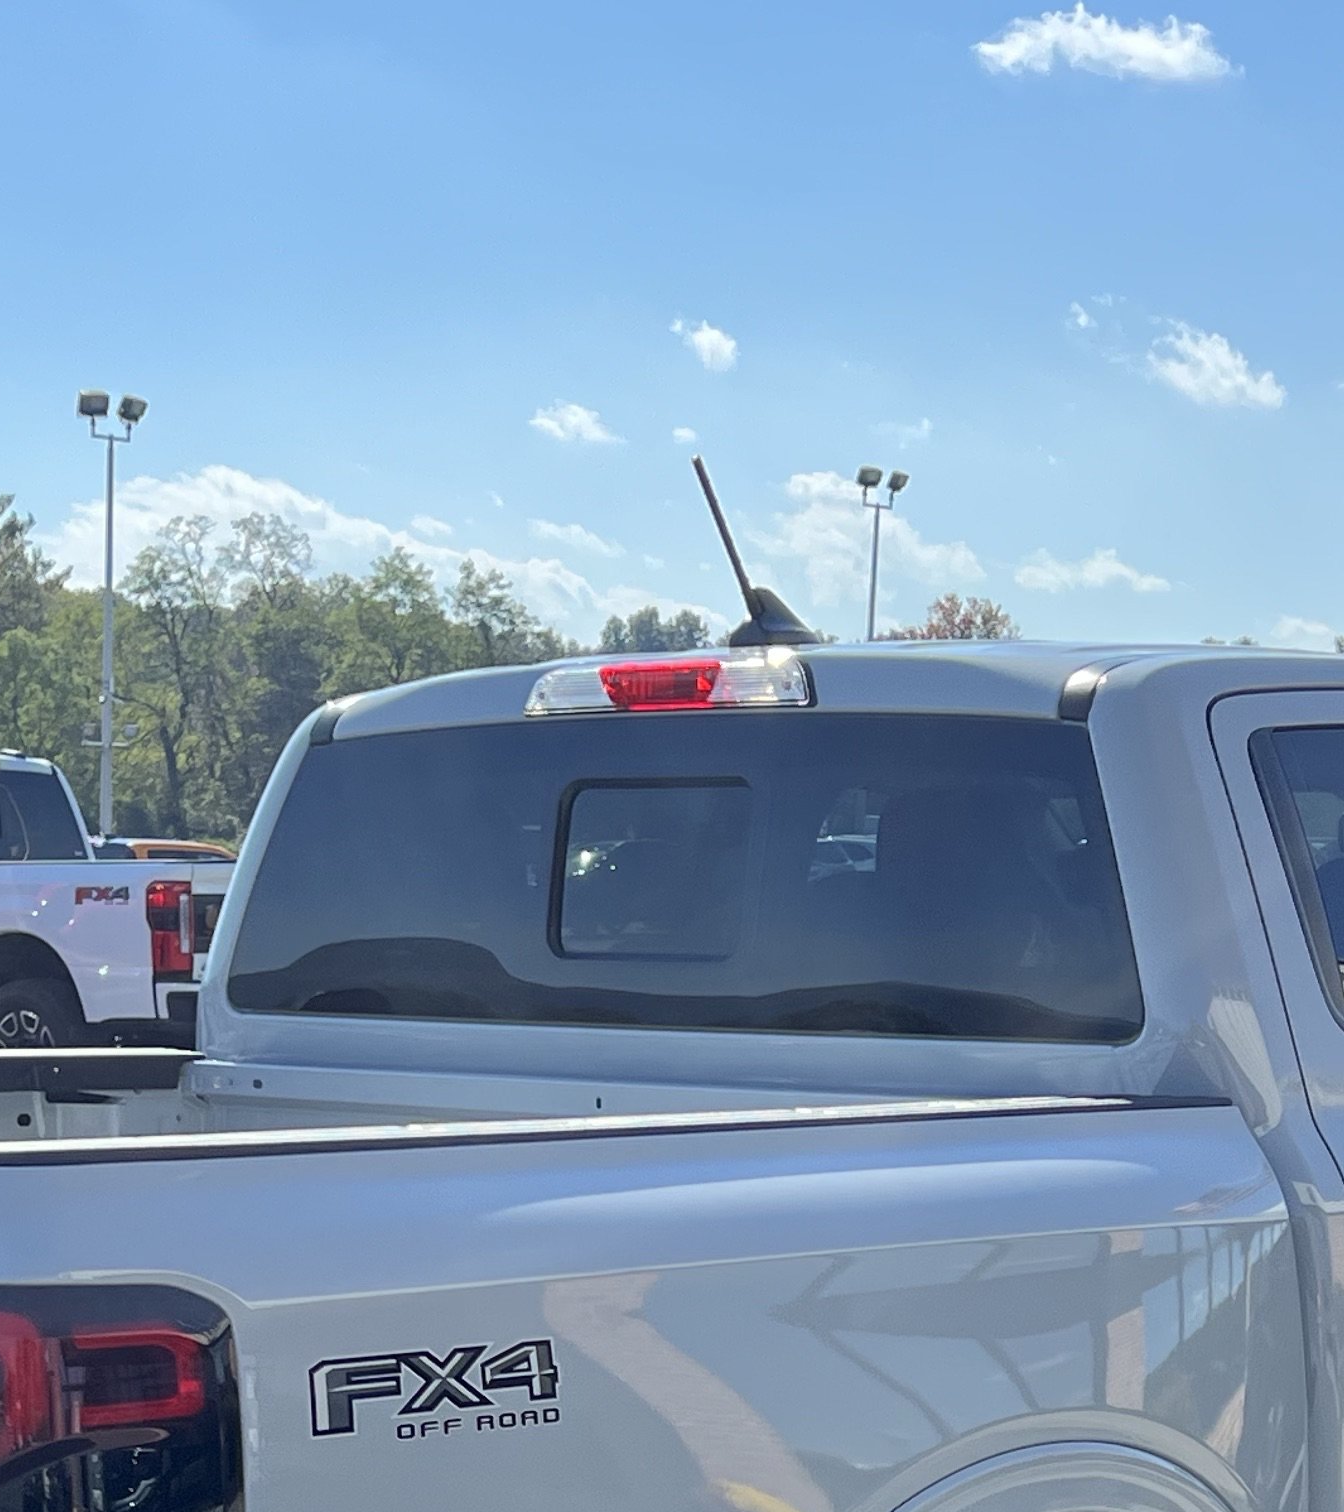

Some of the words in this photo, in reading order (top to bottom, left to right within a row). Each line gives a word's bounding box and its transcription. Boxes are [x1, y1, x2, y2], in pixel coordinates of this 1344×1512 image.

[74, 886, 130, 905] FX4
[309, 1338, 559, 1437] FX4
[396, 1418, 462, 1440] OFF
[476, 1407, 560, 1431] ROAD
